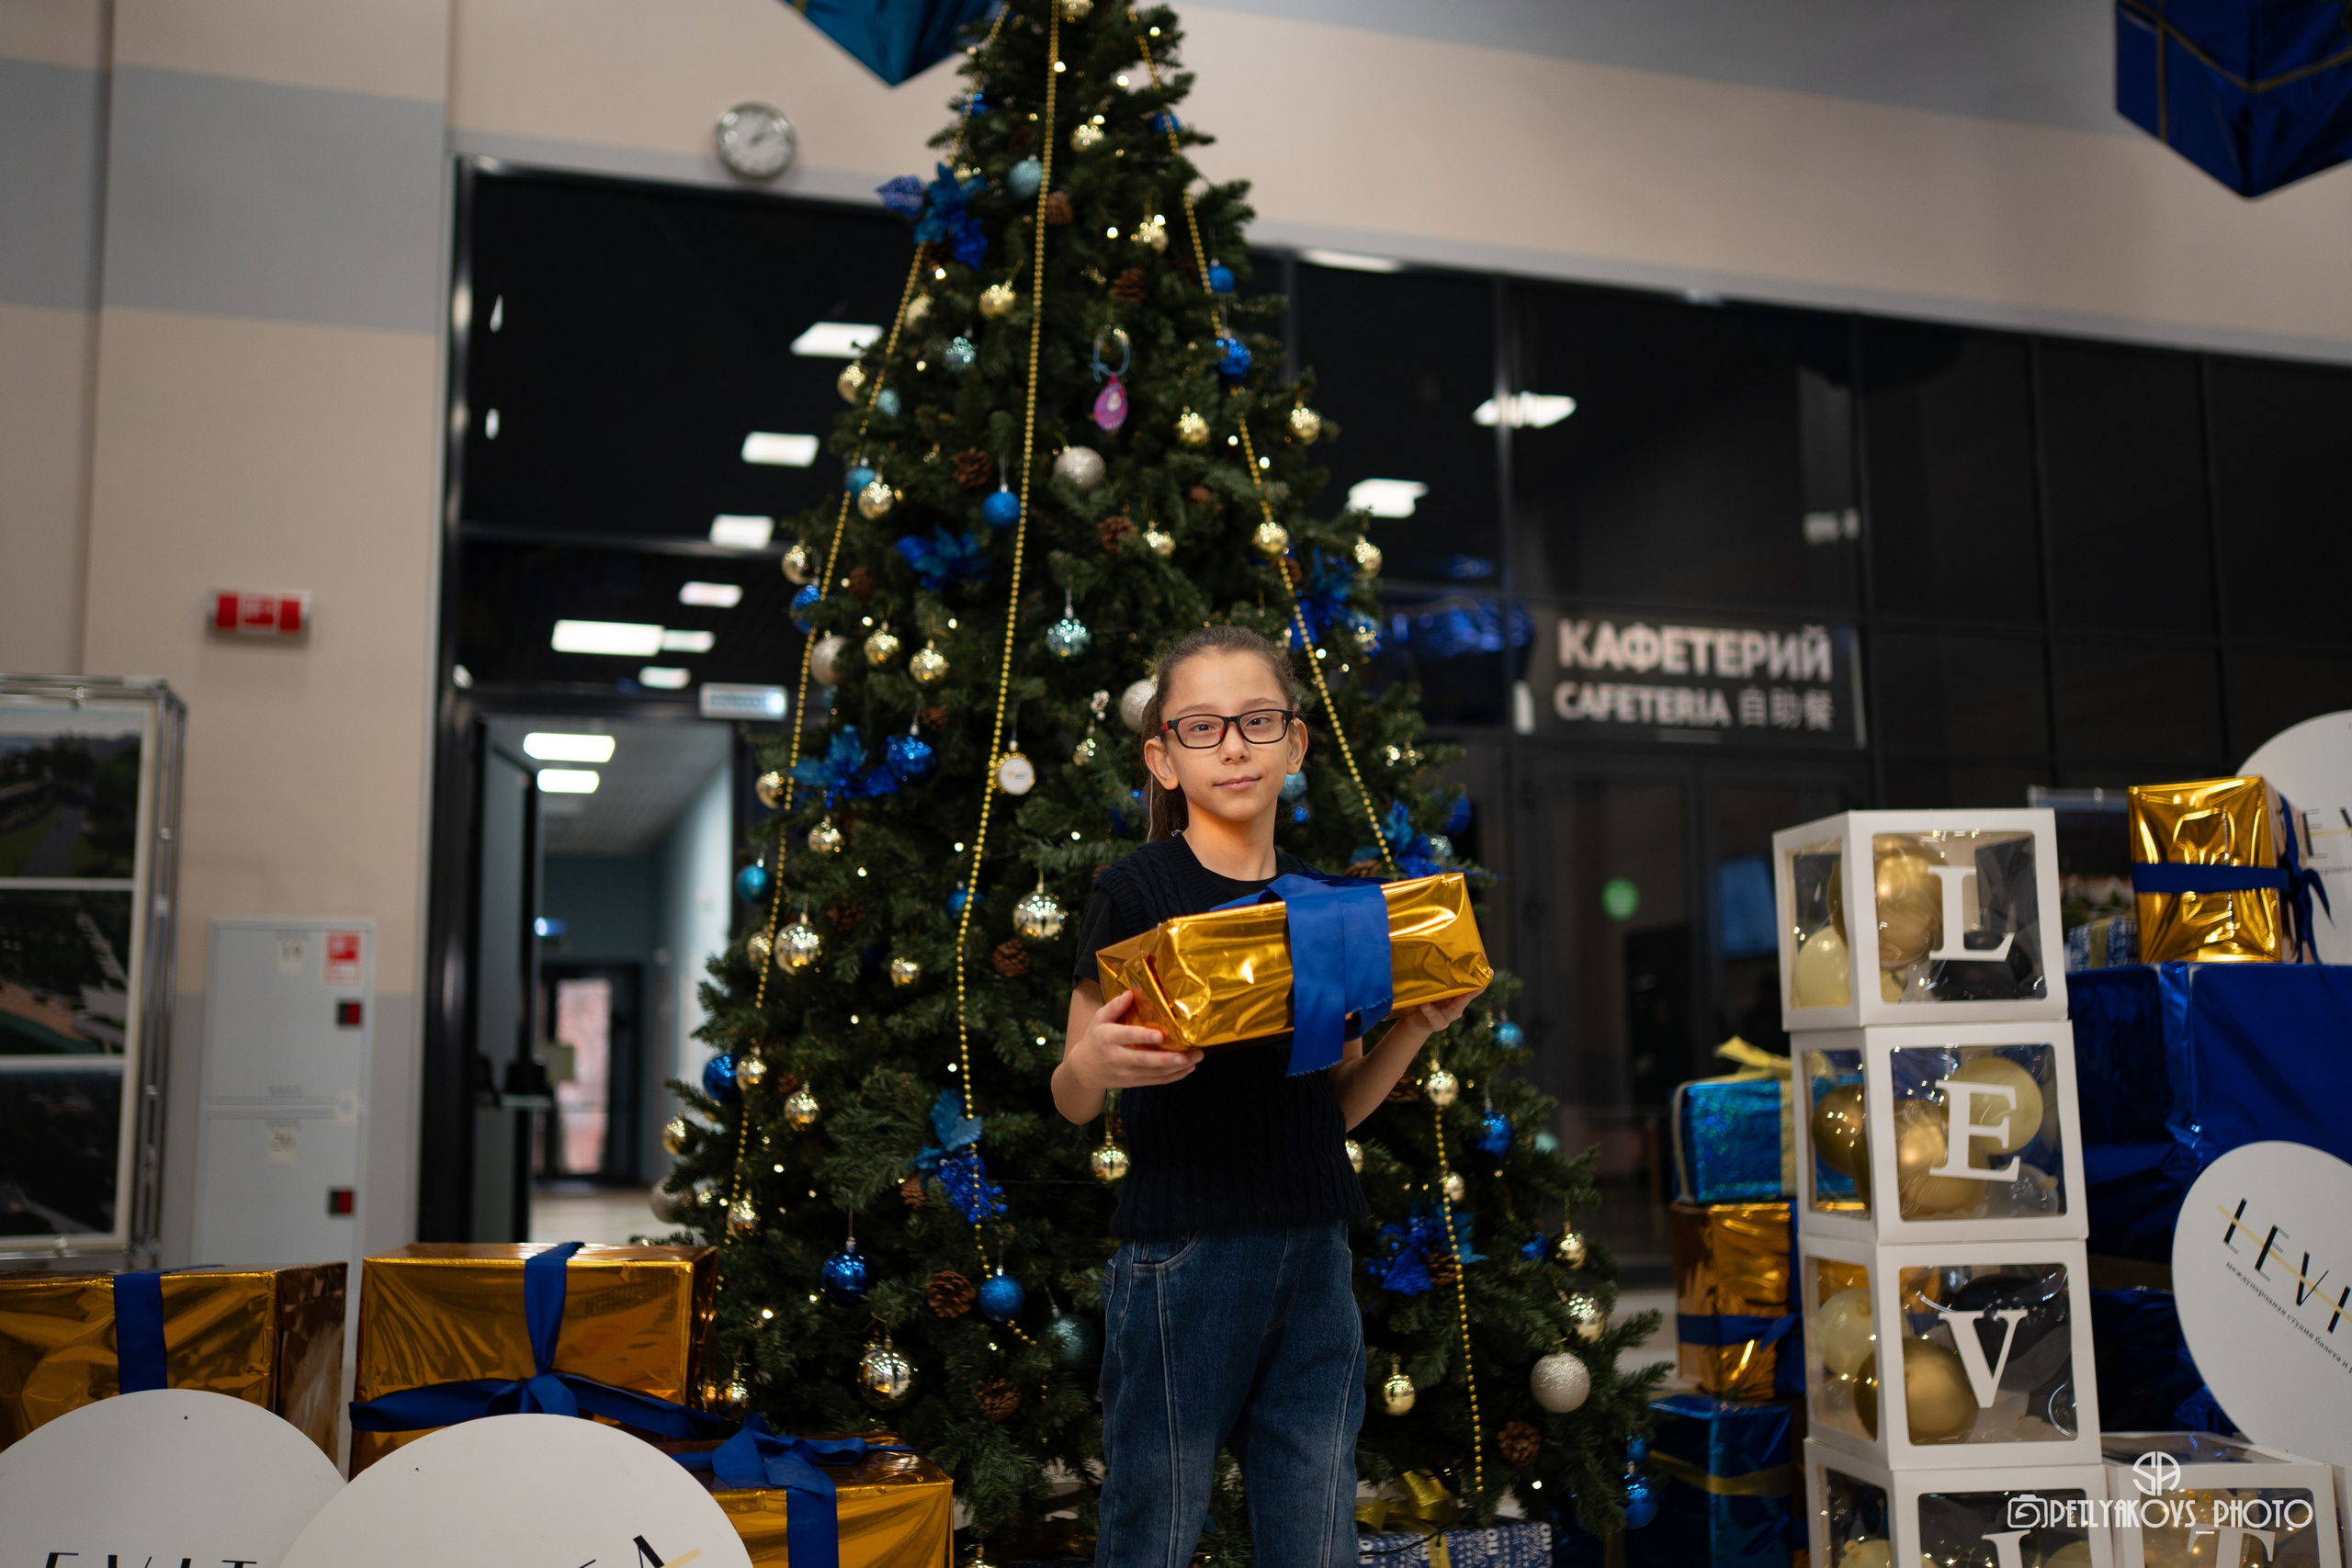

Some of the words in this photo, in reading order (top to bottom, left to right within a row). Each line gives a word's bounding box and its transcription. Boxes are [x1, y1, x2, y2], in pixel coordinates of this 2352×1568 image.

[1559, 619, 1832, 682] КАФЕТЕРИЙ
[1555, 681, 1731, 728] CAFETERIA
[1739, 684, 1835, 731] 自助餐
